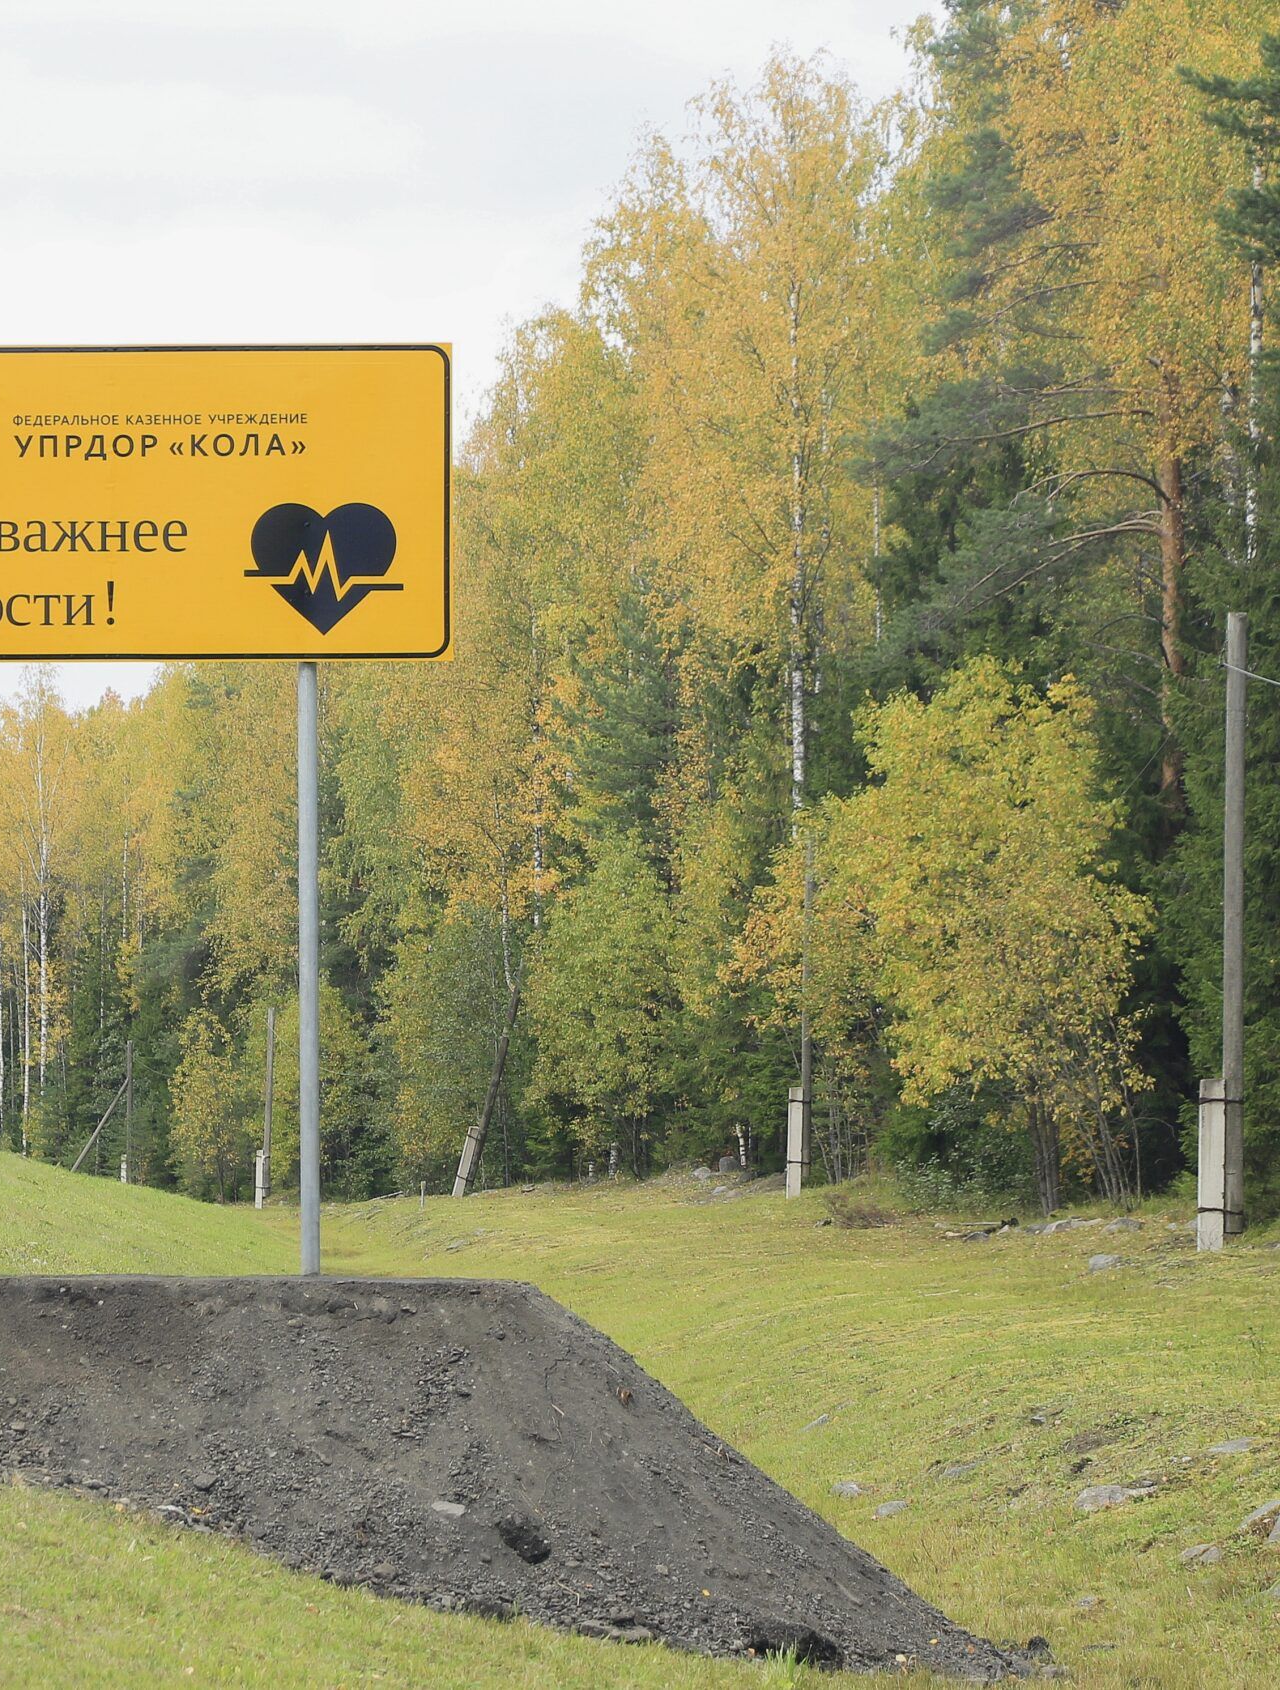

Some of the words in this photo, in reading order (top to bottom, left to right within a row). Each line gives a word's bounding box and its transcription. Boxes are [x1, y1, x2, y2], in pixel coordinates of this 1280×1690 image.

[12, 414, 119, 427] ФЕДЕРАЛЬНОЕ
[125, 414, 202, 426] КАЗЕННОЕ
[208, 413, 308, 426] УЧРЕЖДЕНИЕ
[13, 434, 158, 461] УПРДОР
[169, 433, 307, 457] «КОЛА»
